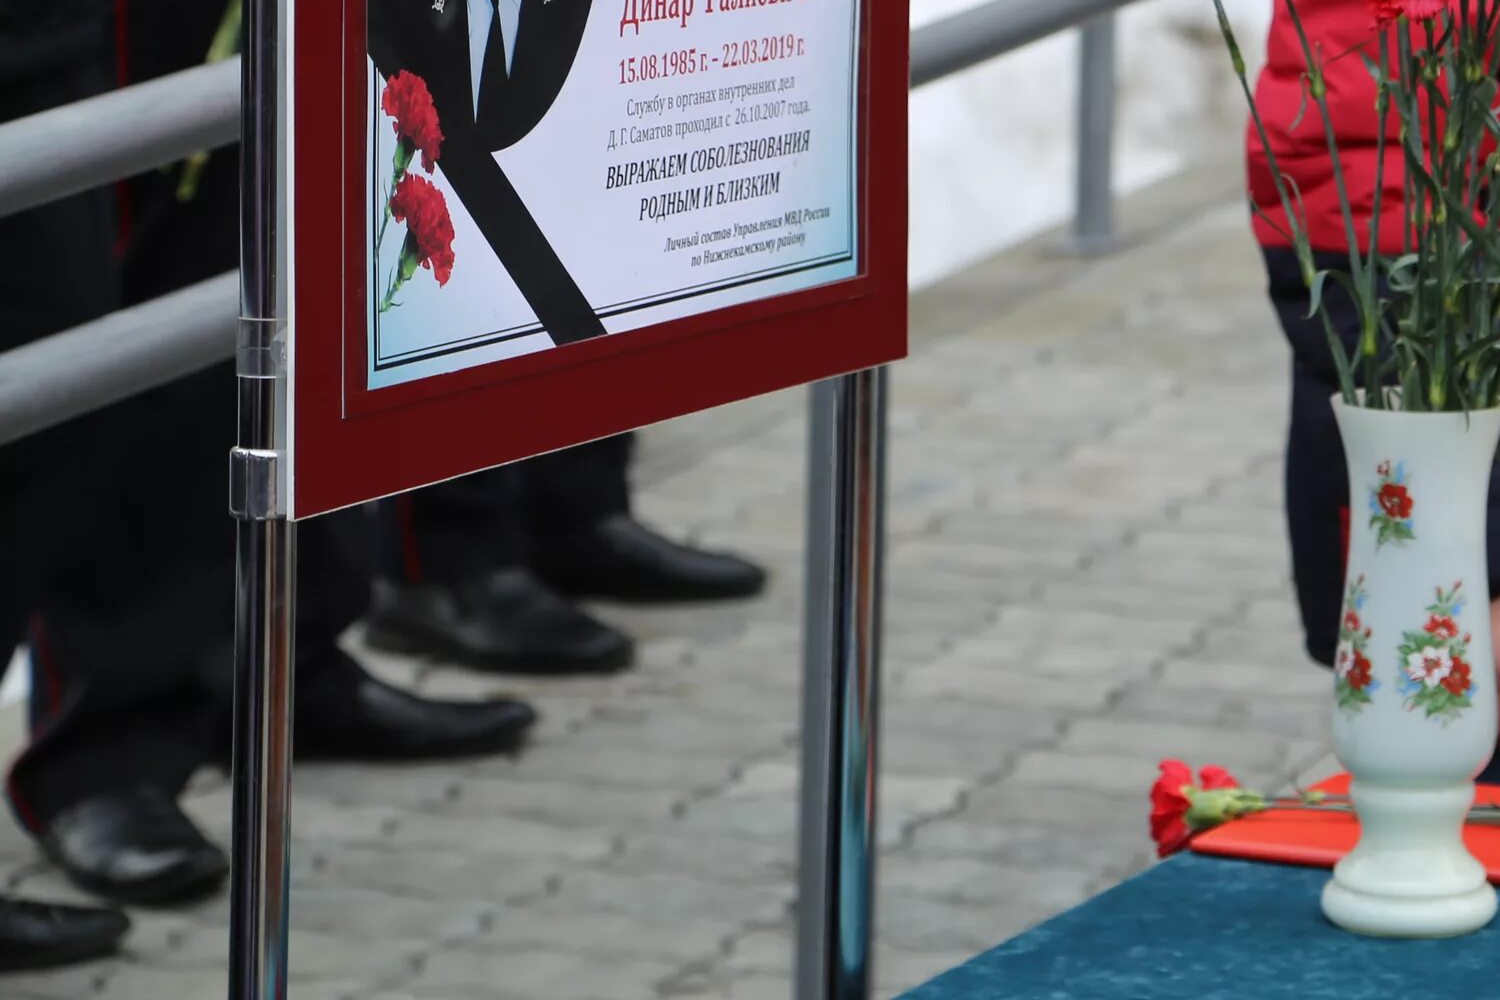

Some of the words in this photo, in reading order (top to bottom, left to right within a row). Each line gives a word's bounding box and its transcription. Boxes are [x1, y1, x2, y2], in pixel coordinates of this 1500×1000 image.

[618, 48, 696, 85] 15.08.1985
[699, 53, 708, 72] г.
[722, 33, 794, 68] 22.03.2019
[796, 37, 805, 56] г.
[626, 94, 666, 119] Службу
[668, 95, 673, 109] в
[676, 88, 716, 112] органах
[718, 78, 776, 104] внутренних
[777, 75, 795, 93] дел
[607, 129, 618, 152] Д.
[620, 127, 628, 146] Г.
[629, 123, 673, 144] Саматов
[675, 114, 723, 140] проходил
[725, 113, 731, 127] с
[734, 100, 786, 125] 26.10.2007
[606, 151, 687, 190] ВЫРАЖАЕМ
[690, 129, 811, 173] СОБОЛЕЗНОВАНИЯ
[639, 186, 701, 223] РОДНЫМ
[703, 184, 714, 208] И
[716, 171, 781, 206] БЛИЗКИМ
